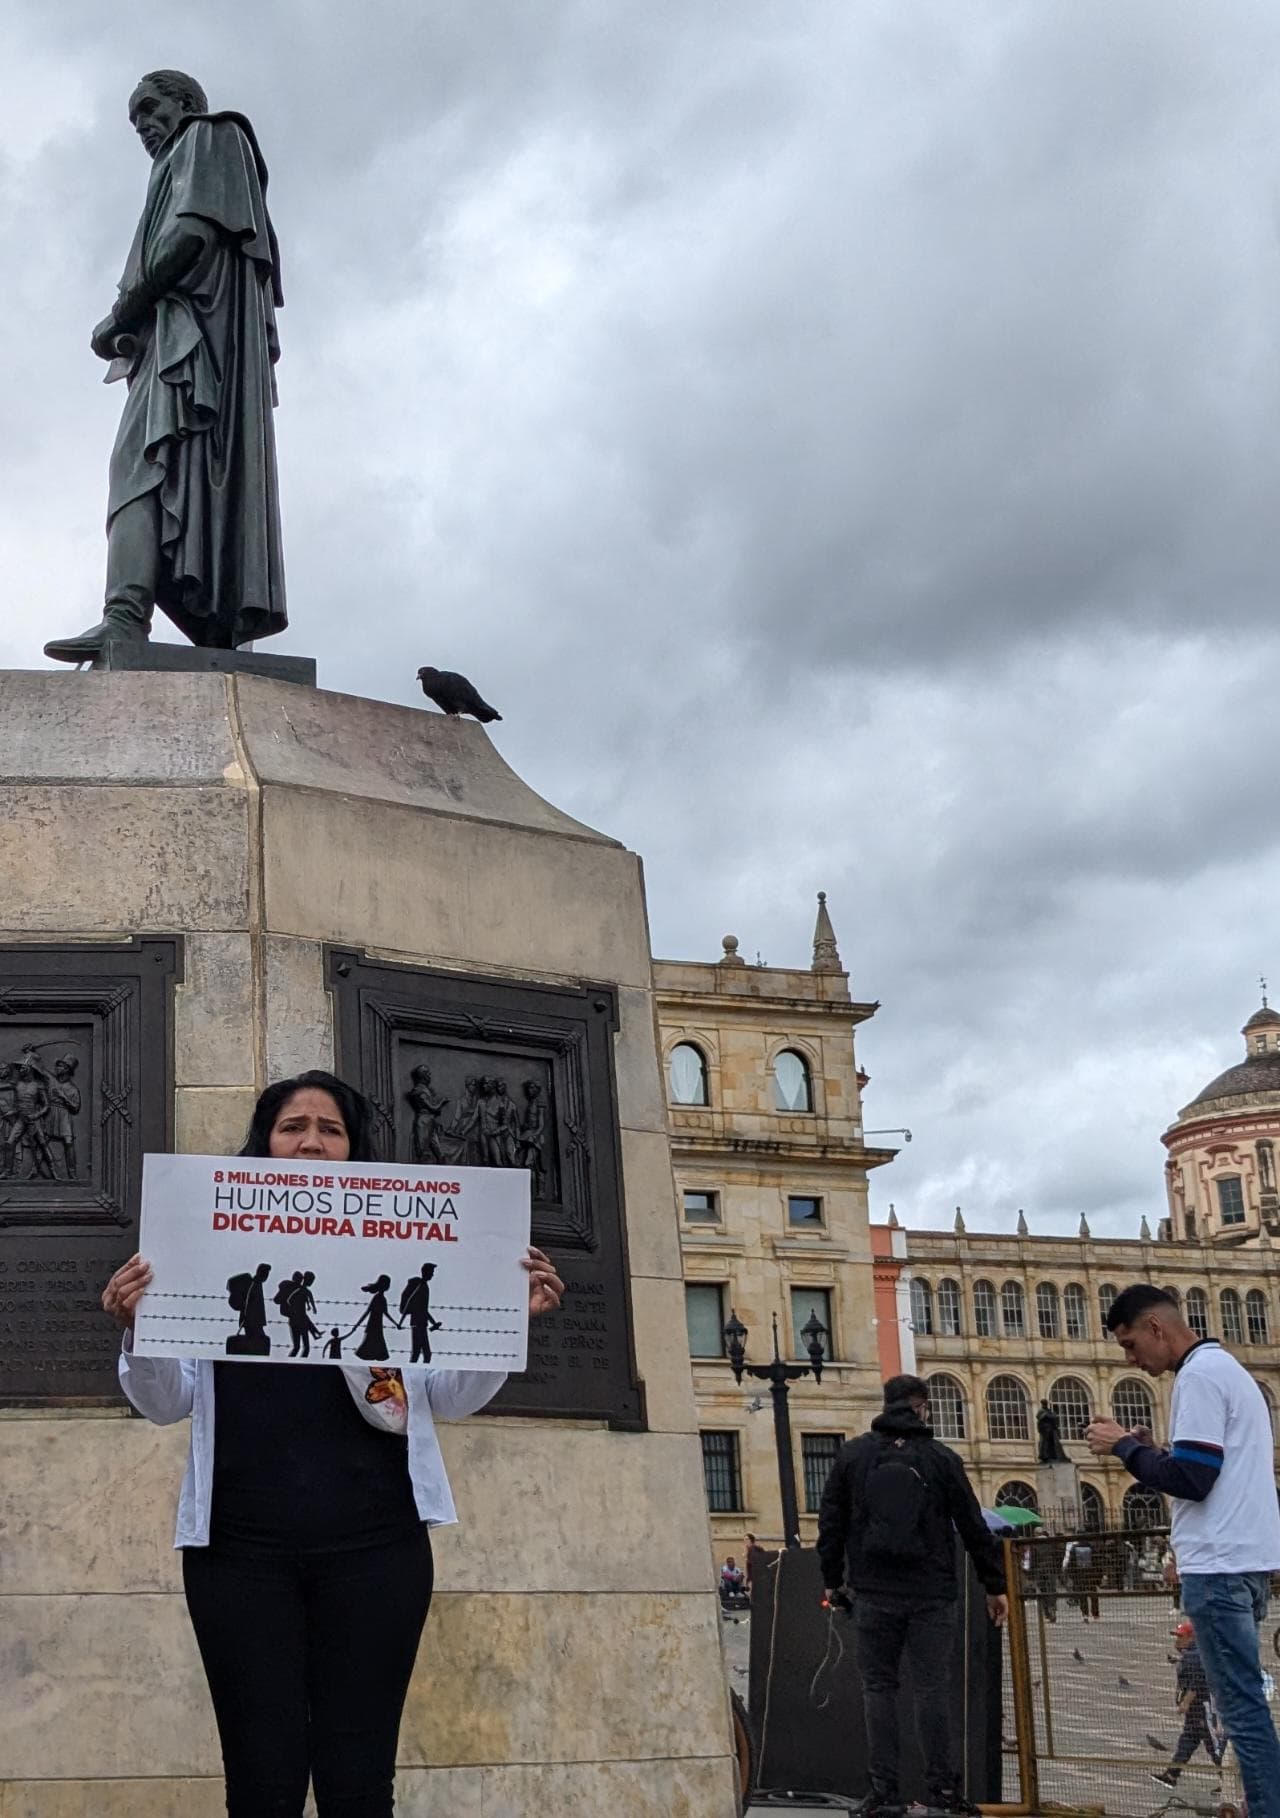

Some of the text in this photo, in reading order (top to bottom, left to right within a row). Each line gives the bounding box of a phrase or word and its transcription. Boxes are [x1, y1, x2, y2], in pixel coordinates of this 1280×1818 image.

[213, 1170, 461, 1195] 8 MILLONES DE VENEZOLANOS
[215, 1186, 459, 1221] HUIMOS DE UNA
[212, 1212, 459, 1243] DICTADURA BRUTAL
